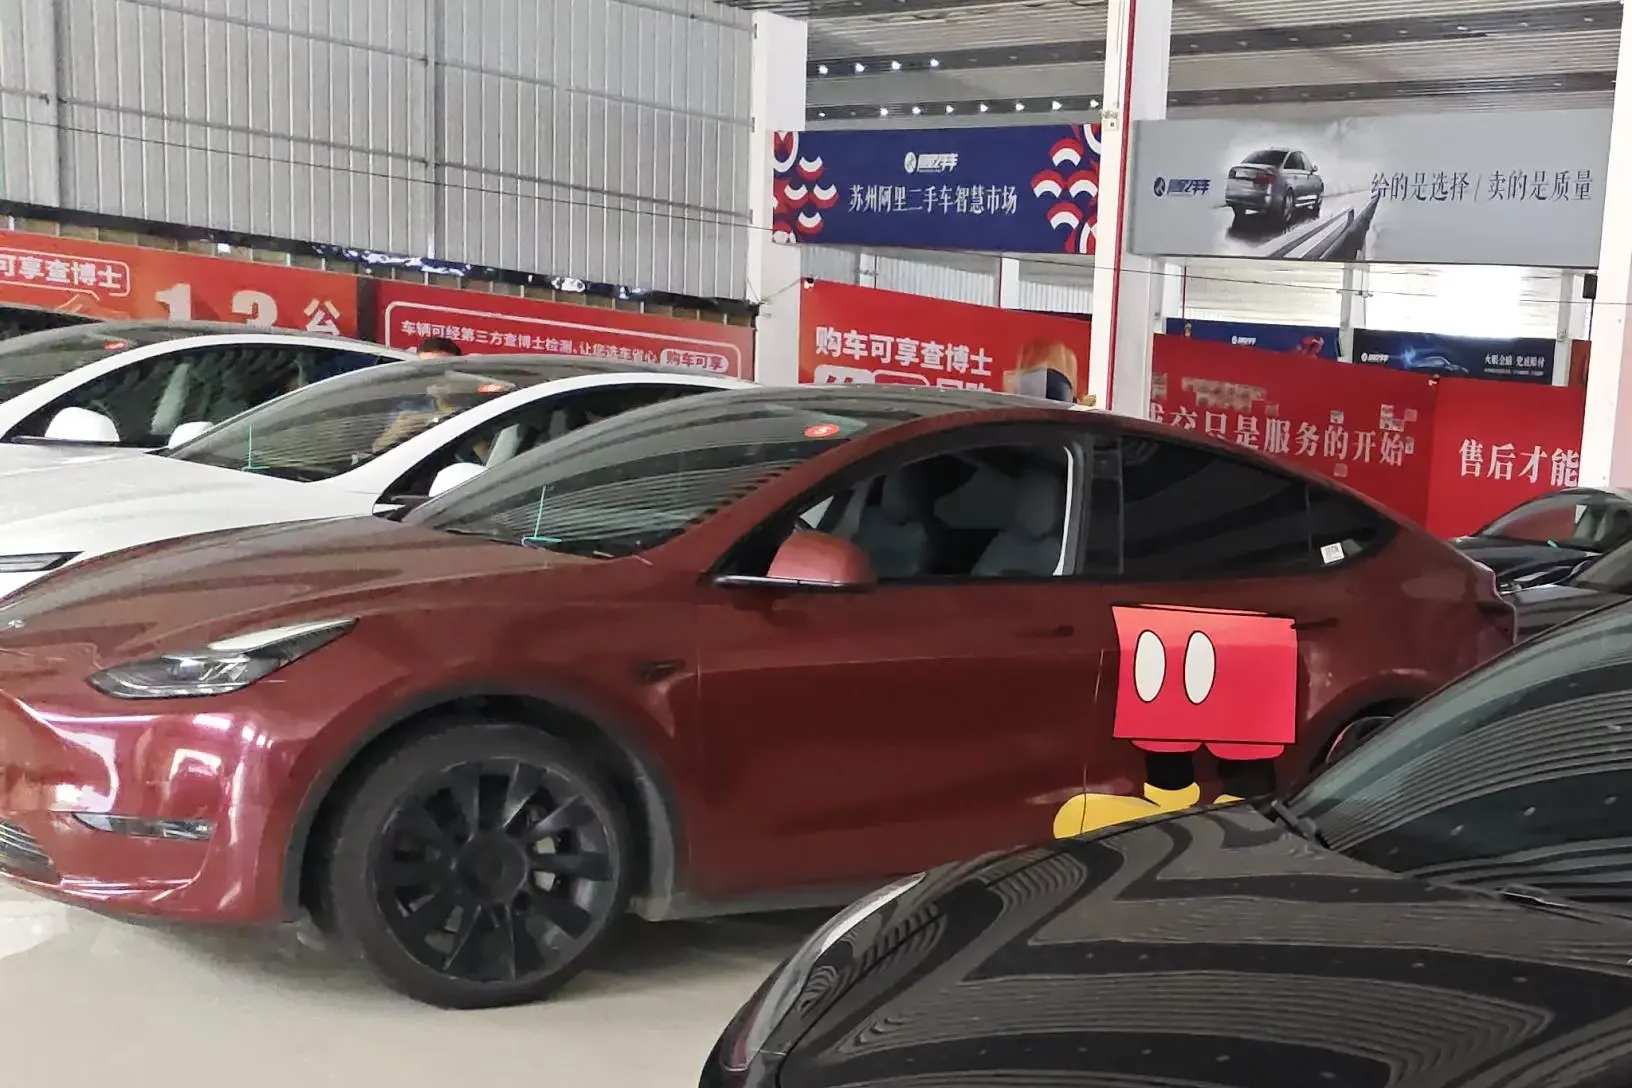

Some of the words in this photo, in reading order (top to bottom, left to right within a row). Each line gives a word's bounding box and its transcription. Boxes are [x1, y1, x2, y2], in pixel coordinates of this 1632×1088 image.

[848, 184, 1017, 215] 苏州阿里二手车智慧市场
[1371, 171, 1470, 202] 给的是选择
[1487, 169, 1594, 202] 卖的是质量
[815, 326, 993, 377] 购车可享查博士
[1459, 439, 1580, 488] 售后才能
